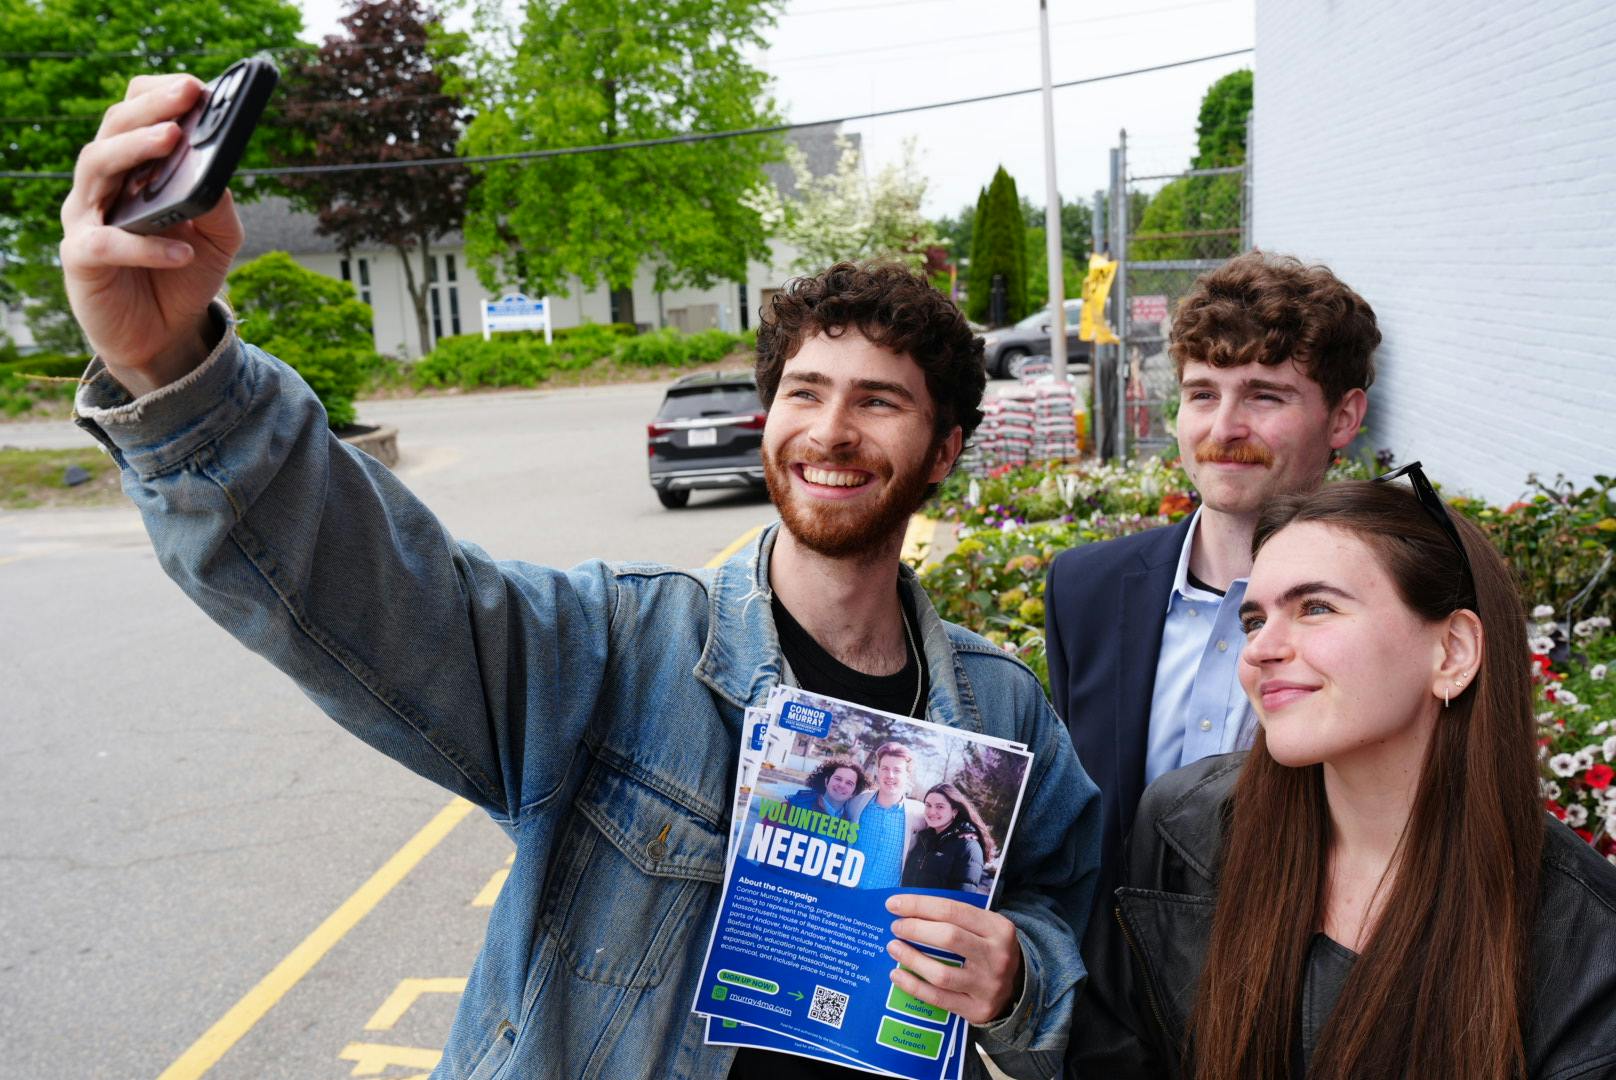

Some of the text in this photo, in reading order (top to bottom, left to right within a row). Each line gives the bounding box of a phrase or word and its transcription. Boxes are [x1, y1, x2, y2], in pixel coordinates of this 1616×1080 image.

[788, 712, 824, 726] MURRAY
[790, 704, 826, 720] CONNOR
[758, 798, 860, 844] VOLUNTEERS
[747, 823, 865, 888] NEEDED
[738, 876, 817, 903] About the Campaign
[731, 901, 777, 918] Massachusetts
[778, 914, 798, 923] House
[806, 921, 856, 942] Representatives,
[856, 938, 884, 953] covering
[733, 894, 758, 905] running
[766, 902, 796, 915] represent
[821, 917, 838, 926] Essex
[838, 923, 860, 934] District
[867, 932, 878, 940] the
[736, 885, 759, 896] Connor
[759, 891, 781, 903] Murray
[794, 902, 815, 912] young,
[815, 908, 852, 923] progressive
[852, 918, 884, 933] Democrat
[724, 926, 859, 970] affordability, education reform, clean energy
[729, 910, 745, 919] parts
[754, 916, 781, 928] Andover,
[782, 923, 799, 932] North
[799, 929, 827, 942] Andover,
[828, 937, 861, 953] Tewksbury,
[862, 949, 875, 957] and
[762, 927, 789, 939] priorities
[790, 935, 813, 945] include
[813, 942, 848, 956] healthcare
[720, 942, 758, 957] economical,
[759, 952, 772, 960] and
[772, 955, 799, 968] inclusive
[799, 964, 818, 974] place
[826, 972, 838, 980] call
[838, 976, 857, 987] home.
[722, 934, 755, 948] expansion,
[769, 947, 796, 960] ensuring
[797, 954, 844, 973] Massachusetts
[856, 973, 870, 983] safe,
[722, 971, 773, 991] SIGN UP NOW!
[728, 992, 792, 1016] murray4ma.com
[904, 1002, 933, 1016] Holding
[891, 1035, 927, 1050] Outreach
[902, 1028, 921, 1039] Local
